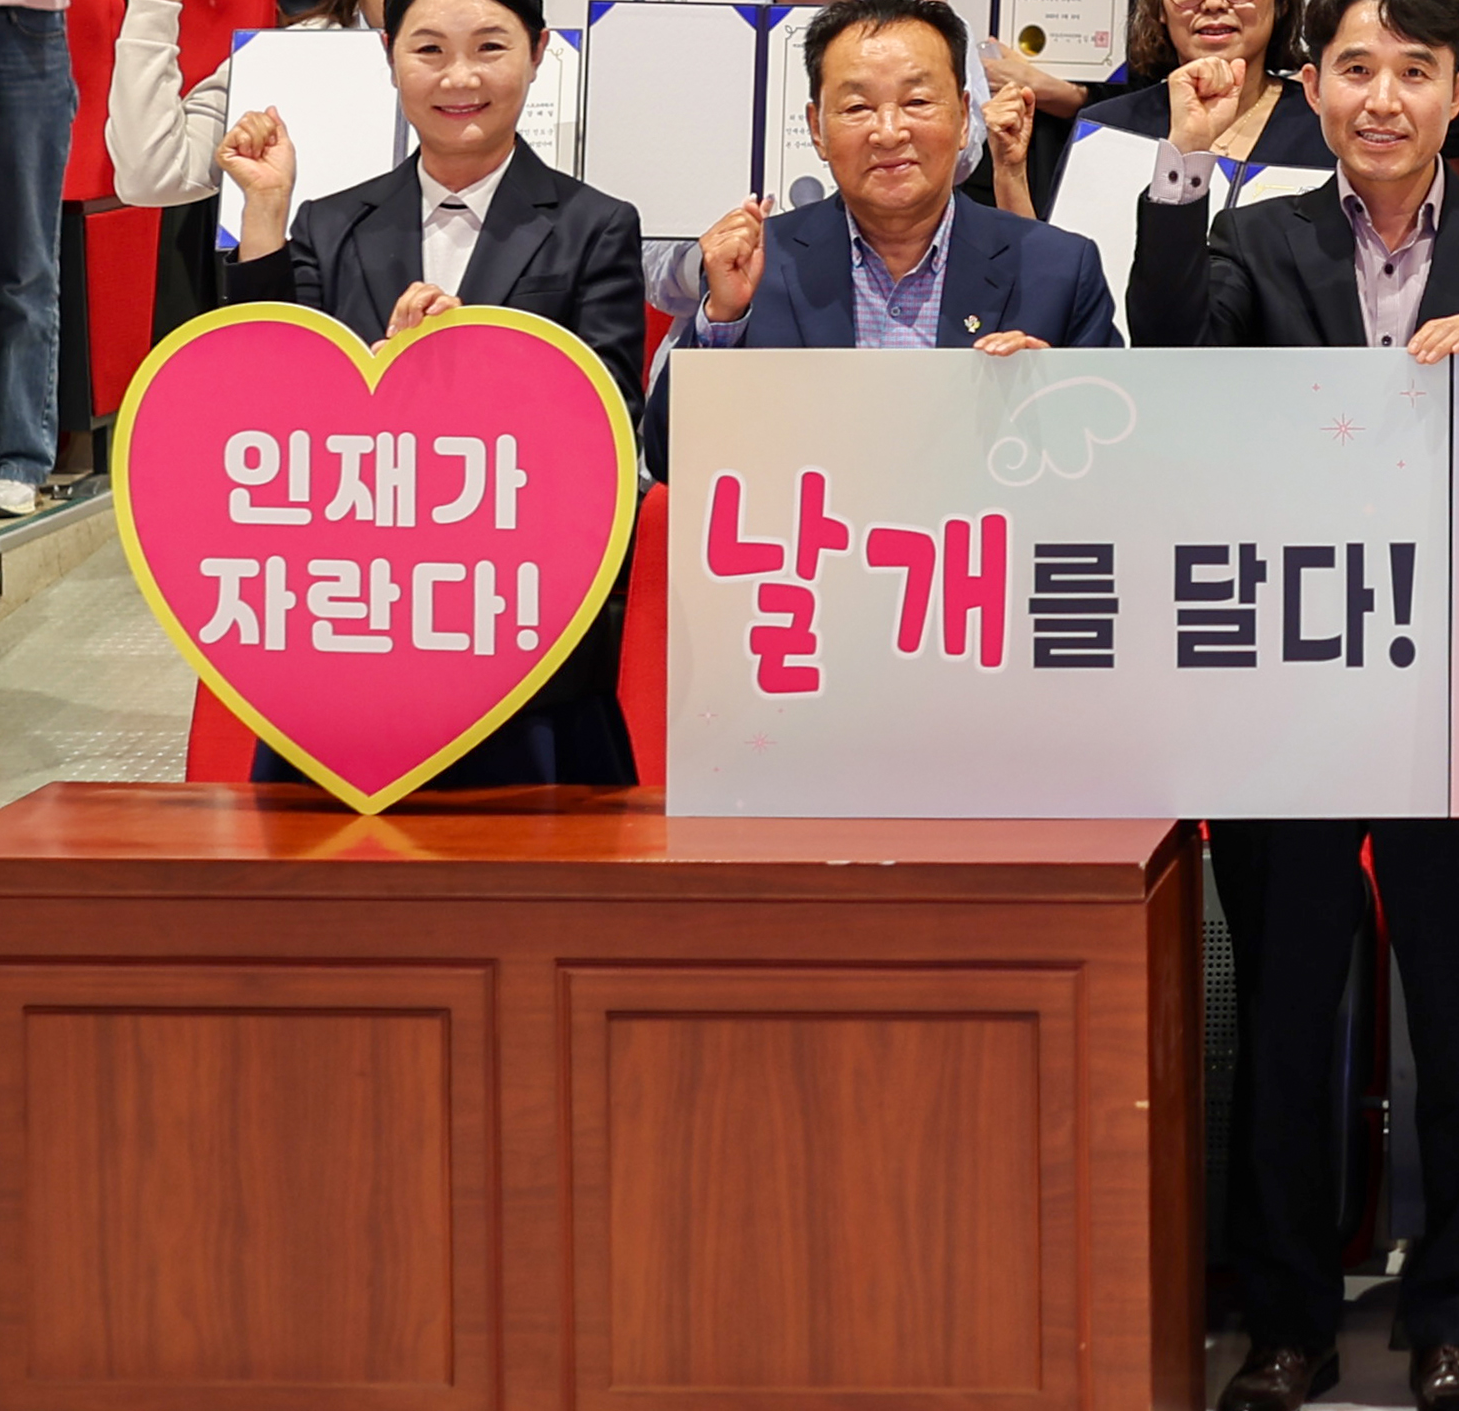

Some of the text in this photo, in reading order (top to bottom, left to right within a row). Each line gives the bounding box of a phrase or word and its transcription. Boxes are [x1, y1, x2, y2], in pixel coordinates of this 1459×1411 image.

[222, 428, 528, 532] 인재가
[196, 555, 542, 657] 자란다!
[703, 470, 1419, 698] 날개를 달다!
